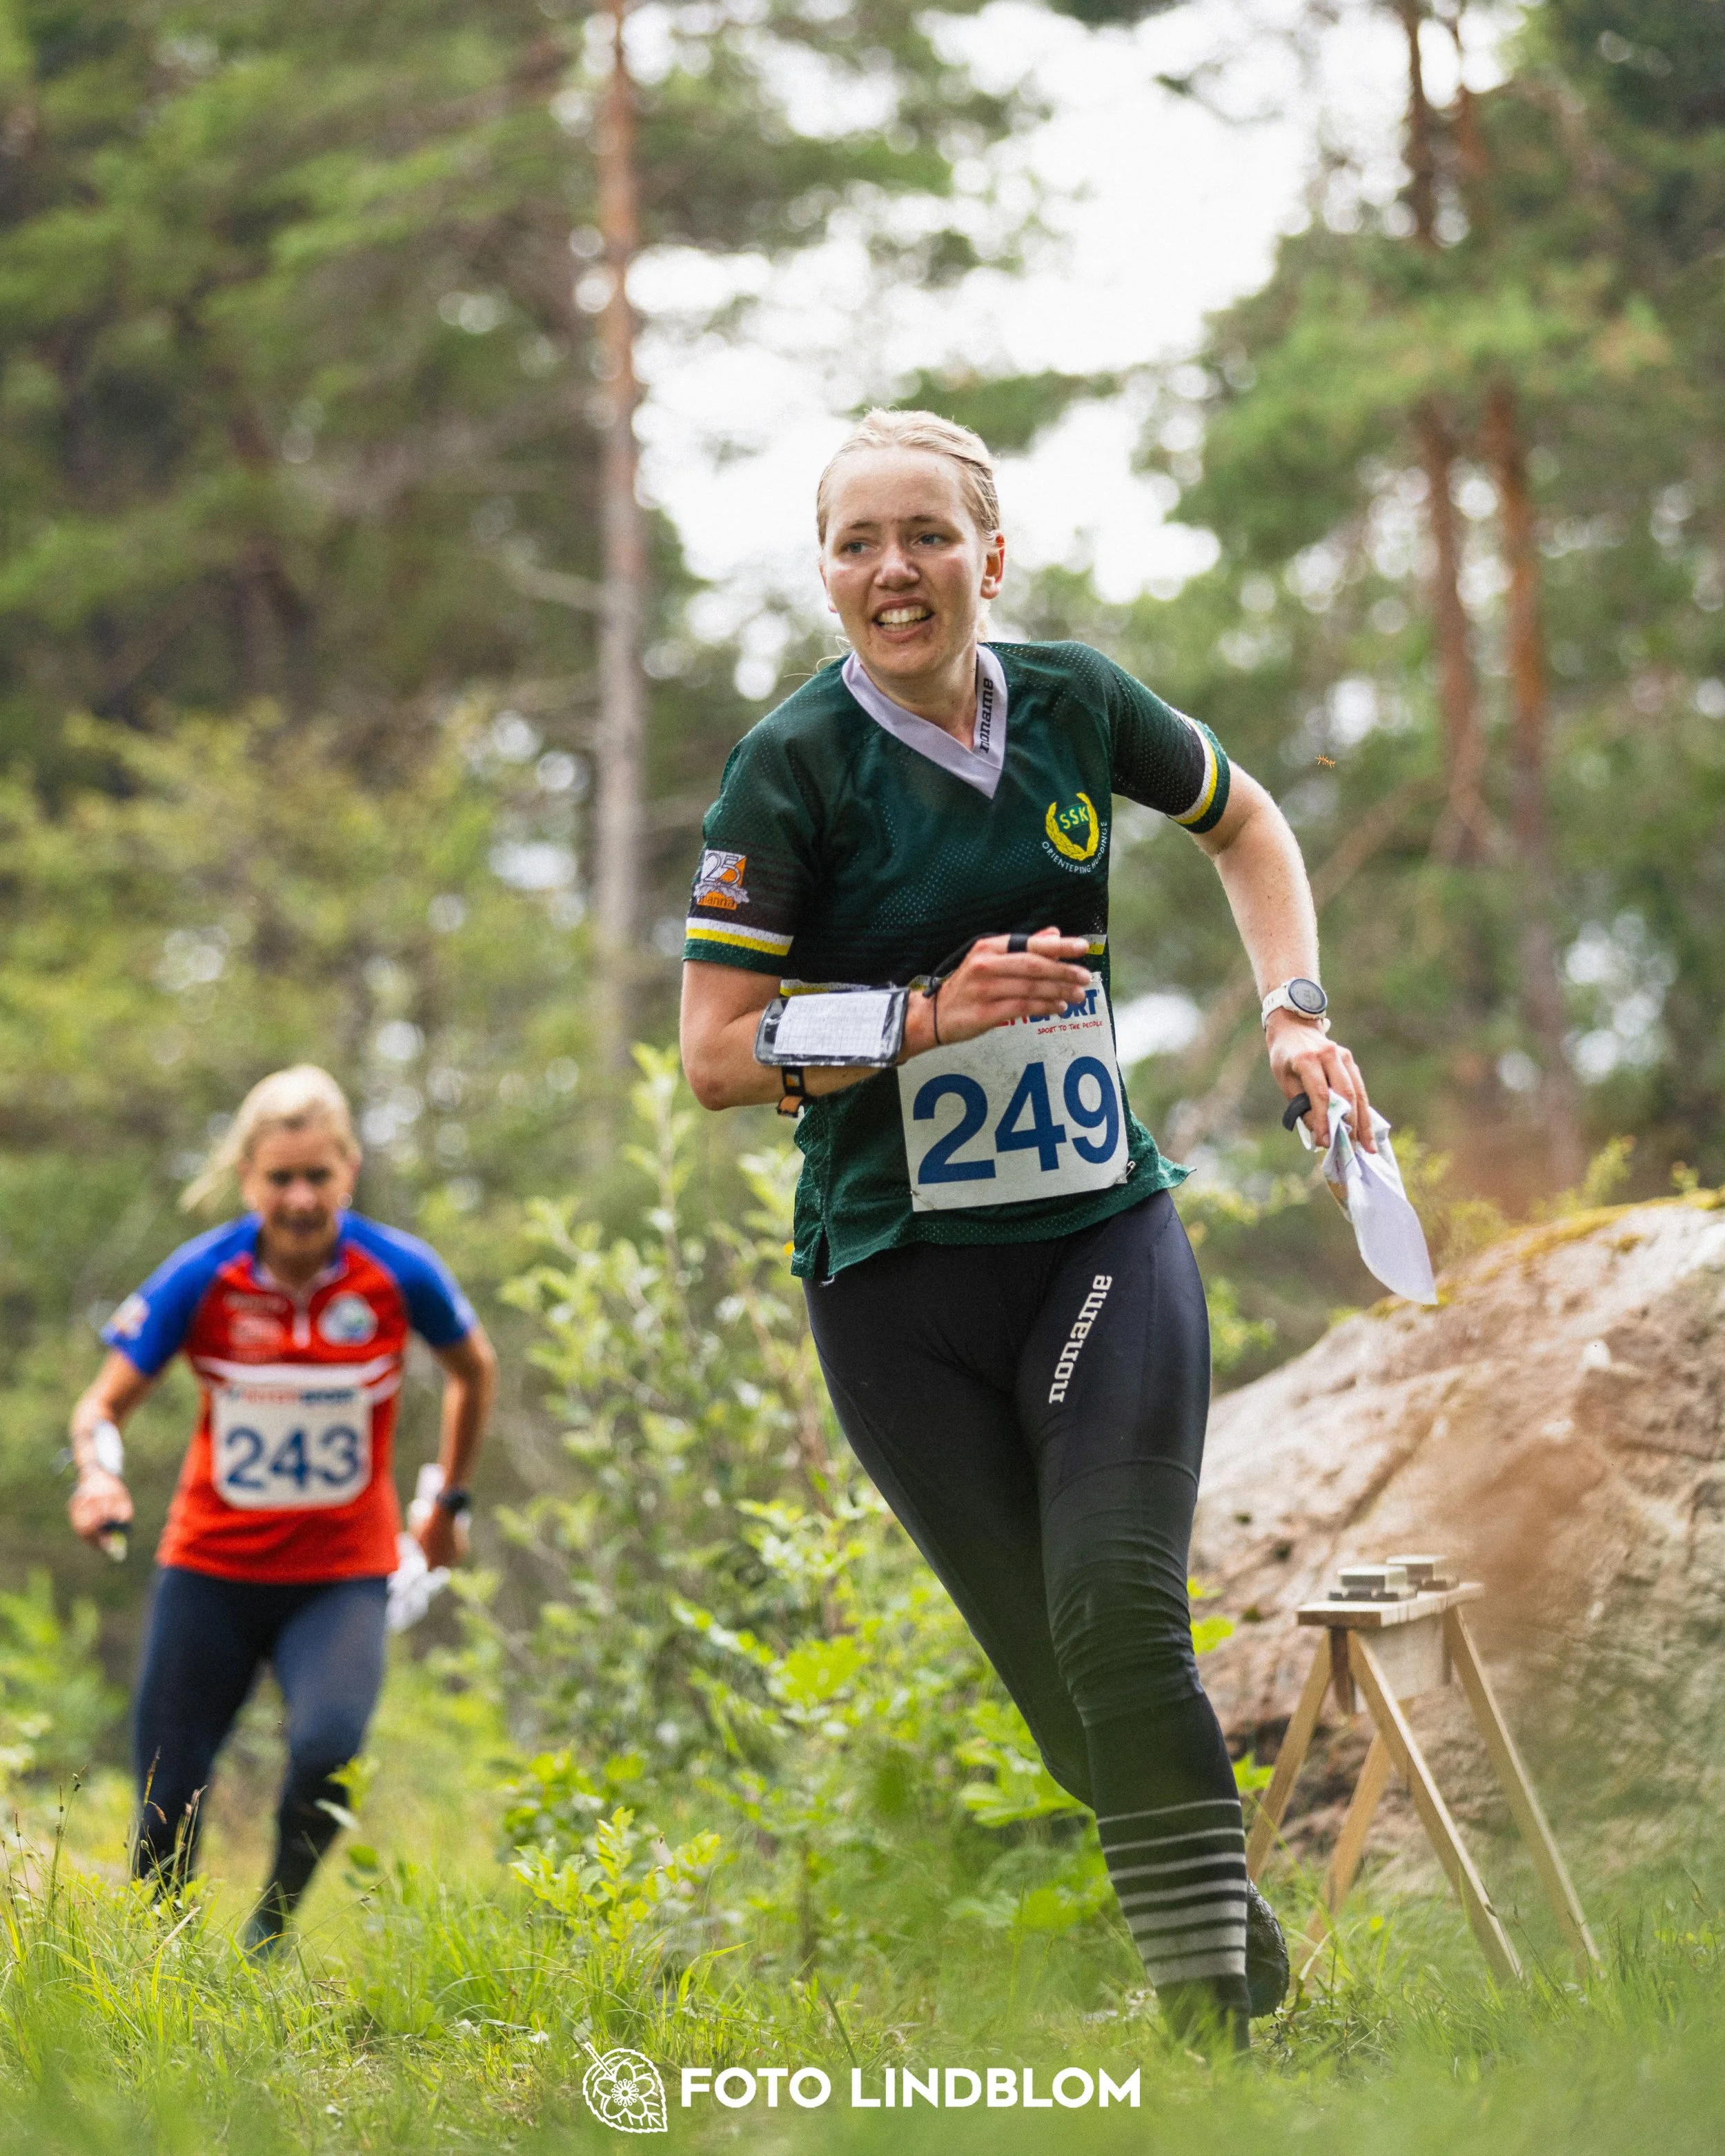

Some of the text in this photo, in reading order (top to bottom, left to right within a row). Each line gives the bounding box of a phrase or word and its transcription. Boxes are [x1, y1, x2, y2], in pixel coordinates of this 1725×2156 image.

[980, 678, 994, 753] noname
[1059, 806, 1089, 829] SSK
[703, 852, 740, 887] 25
[1037, 1026, 1057, 1034] SPORT
[913, 1056, 1119, 1185] 249
[1049, 1275, 1112, 1403] noname
[225, 1424, 360, 1492] 243
